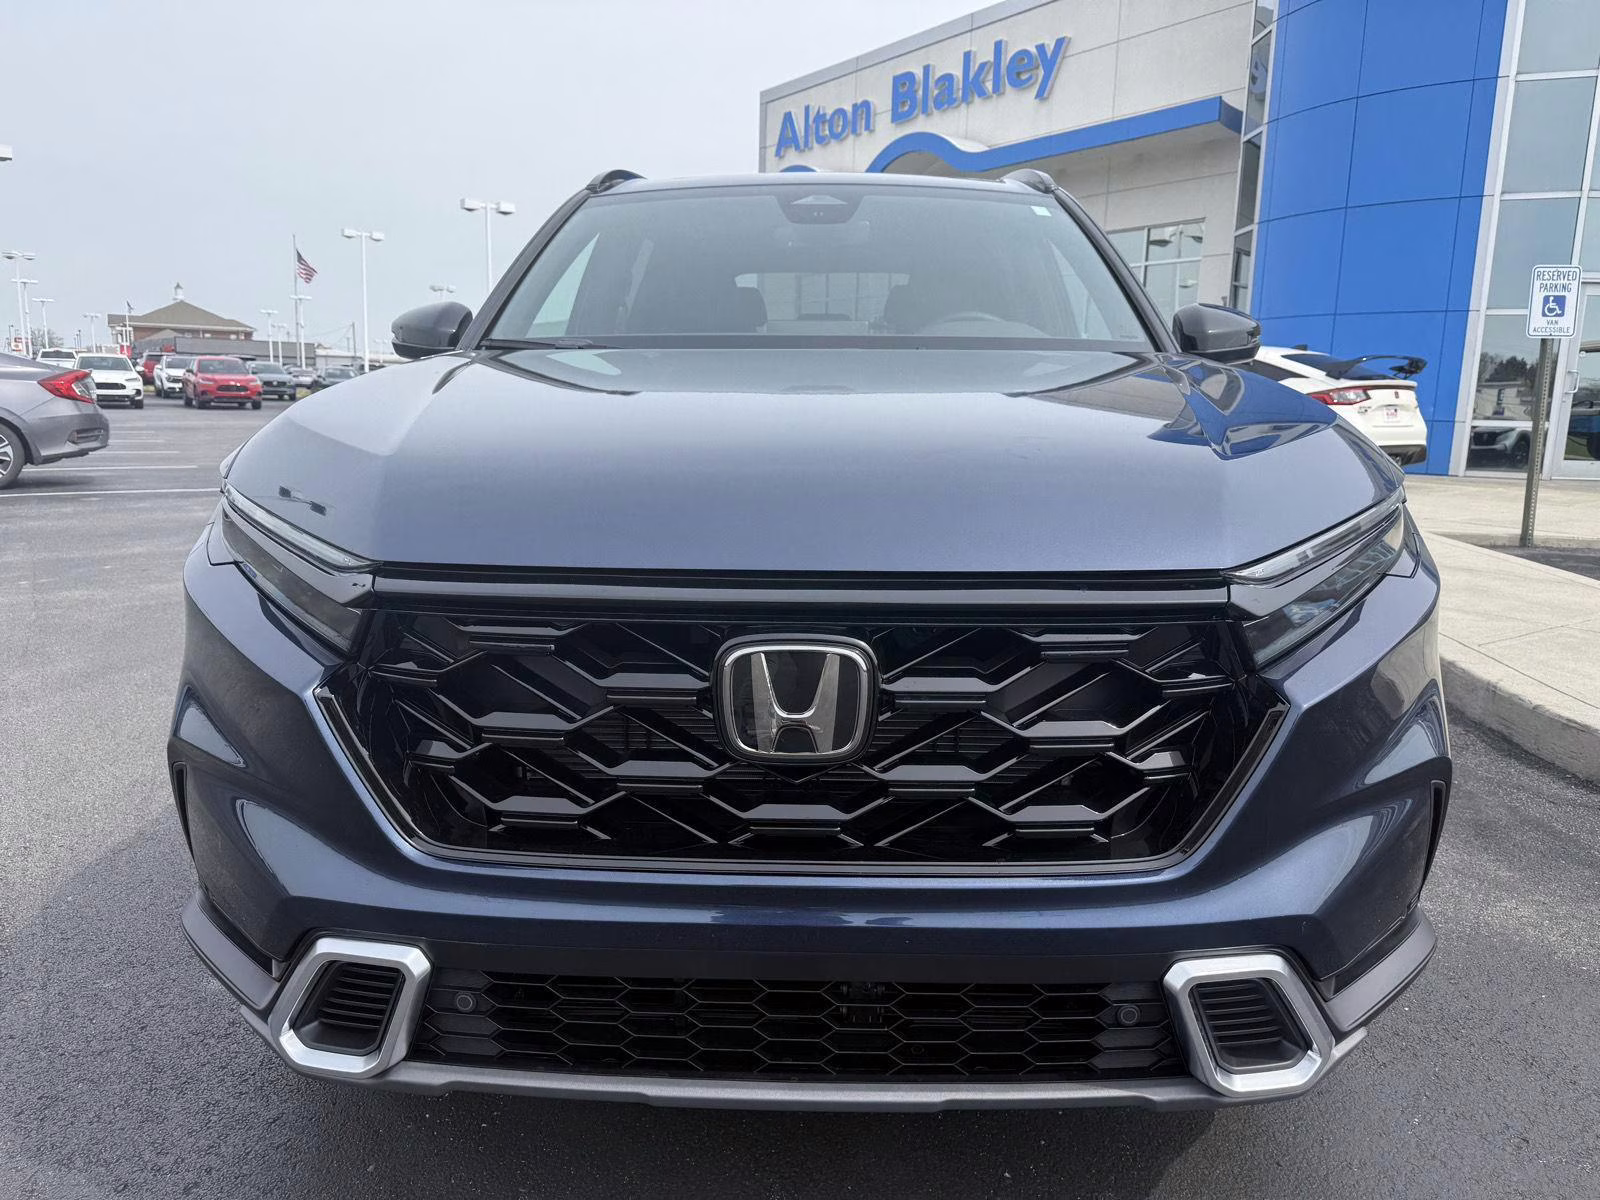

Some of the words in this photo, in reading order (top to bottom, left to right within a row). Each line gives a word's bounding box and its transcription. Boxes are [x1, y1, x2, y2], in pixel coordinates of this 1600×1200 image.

[774, 98, 875, 158] Alton
[890, 36, 1071, 124] Blakley
[1536, 270, 1577, 281] RESERVED
[1539, 282, 1572, 293] PARKING
